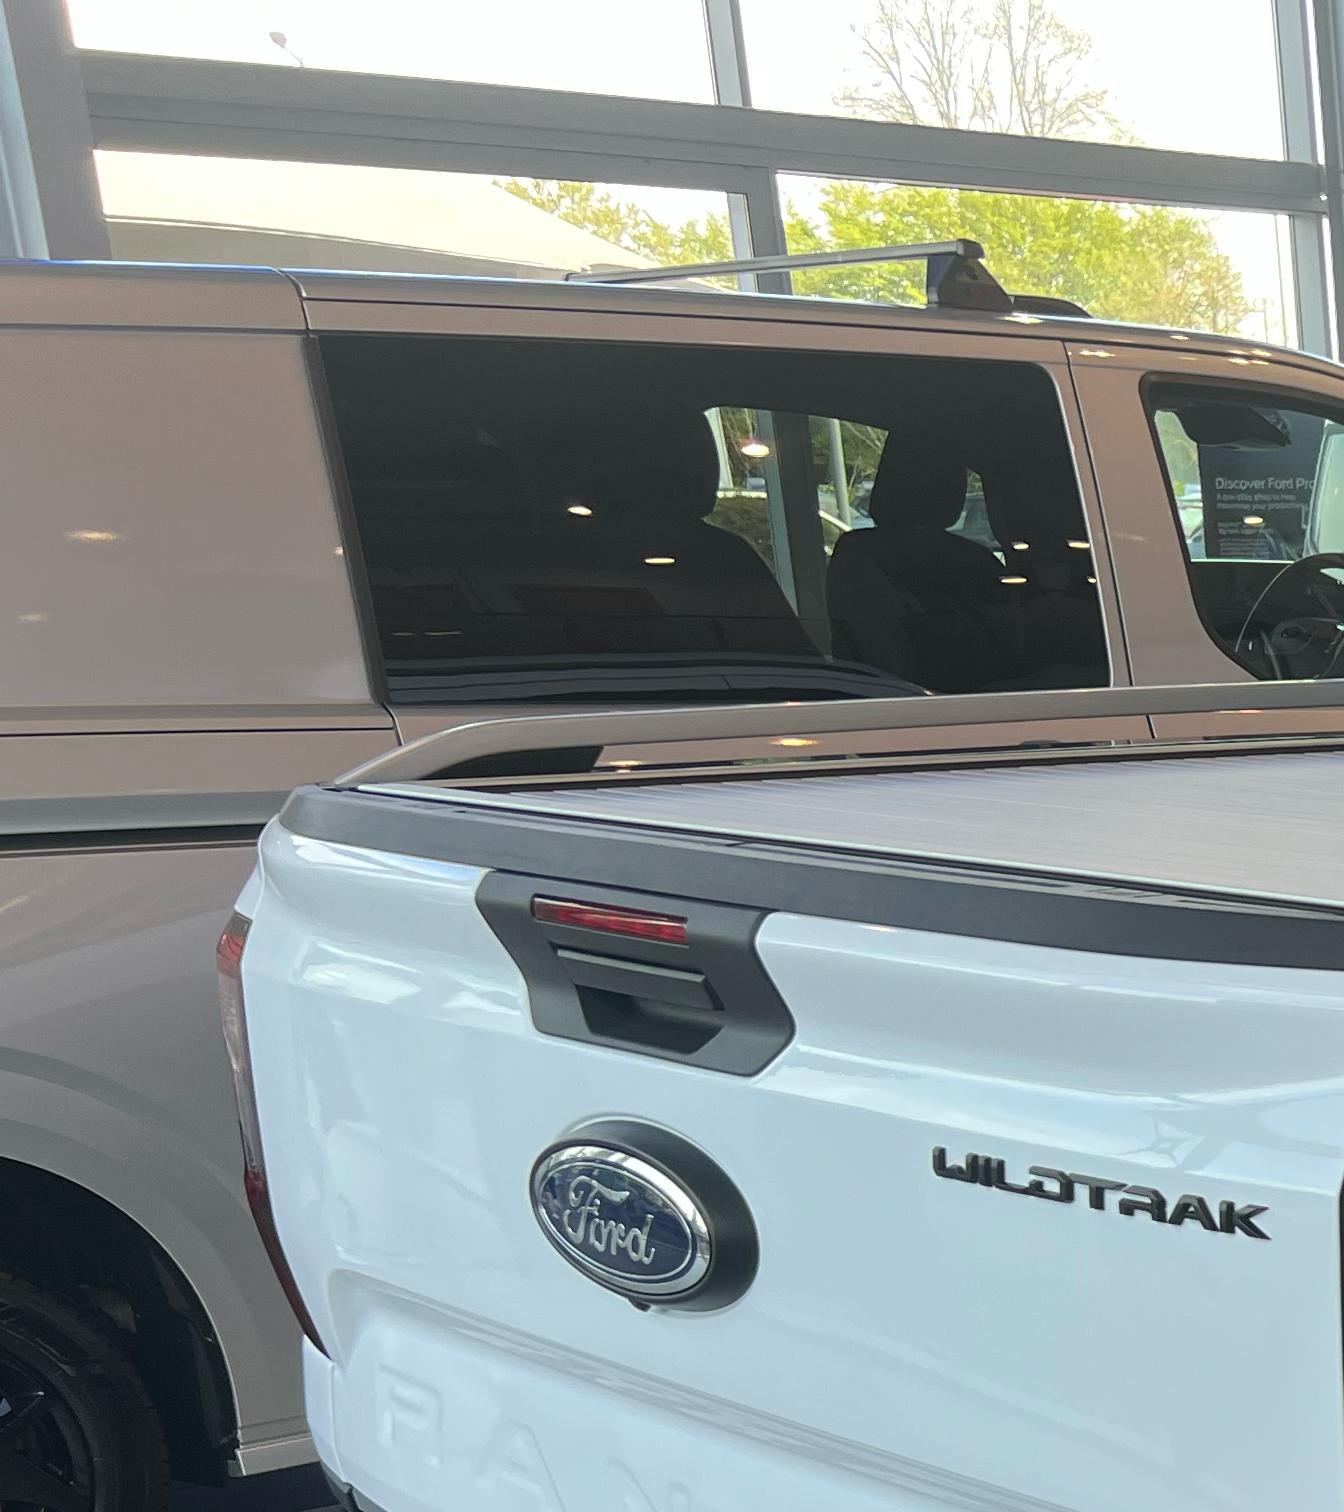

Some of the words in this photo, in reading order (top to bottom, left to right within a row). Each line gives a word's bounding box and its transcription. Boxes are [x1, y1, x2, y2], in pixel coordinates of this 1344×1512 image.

[1215, 477, 1265, 490] Discover
[1267, 477, 1294, 490] Ford
[563, 1173, 656, 1266] Ford
[931, 1145, 1272, 1242] WILDTRAK
